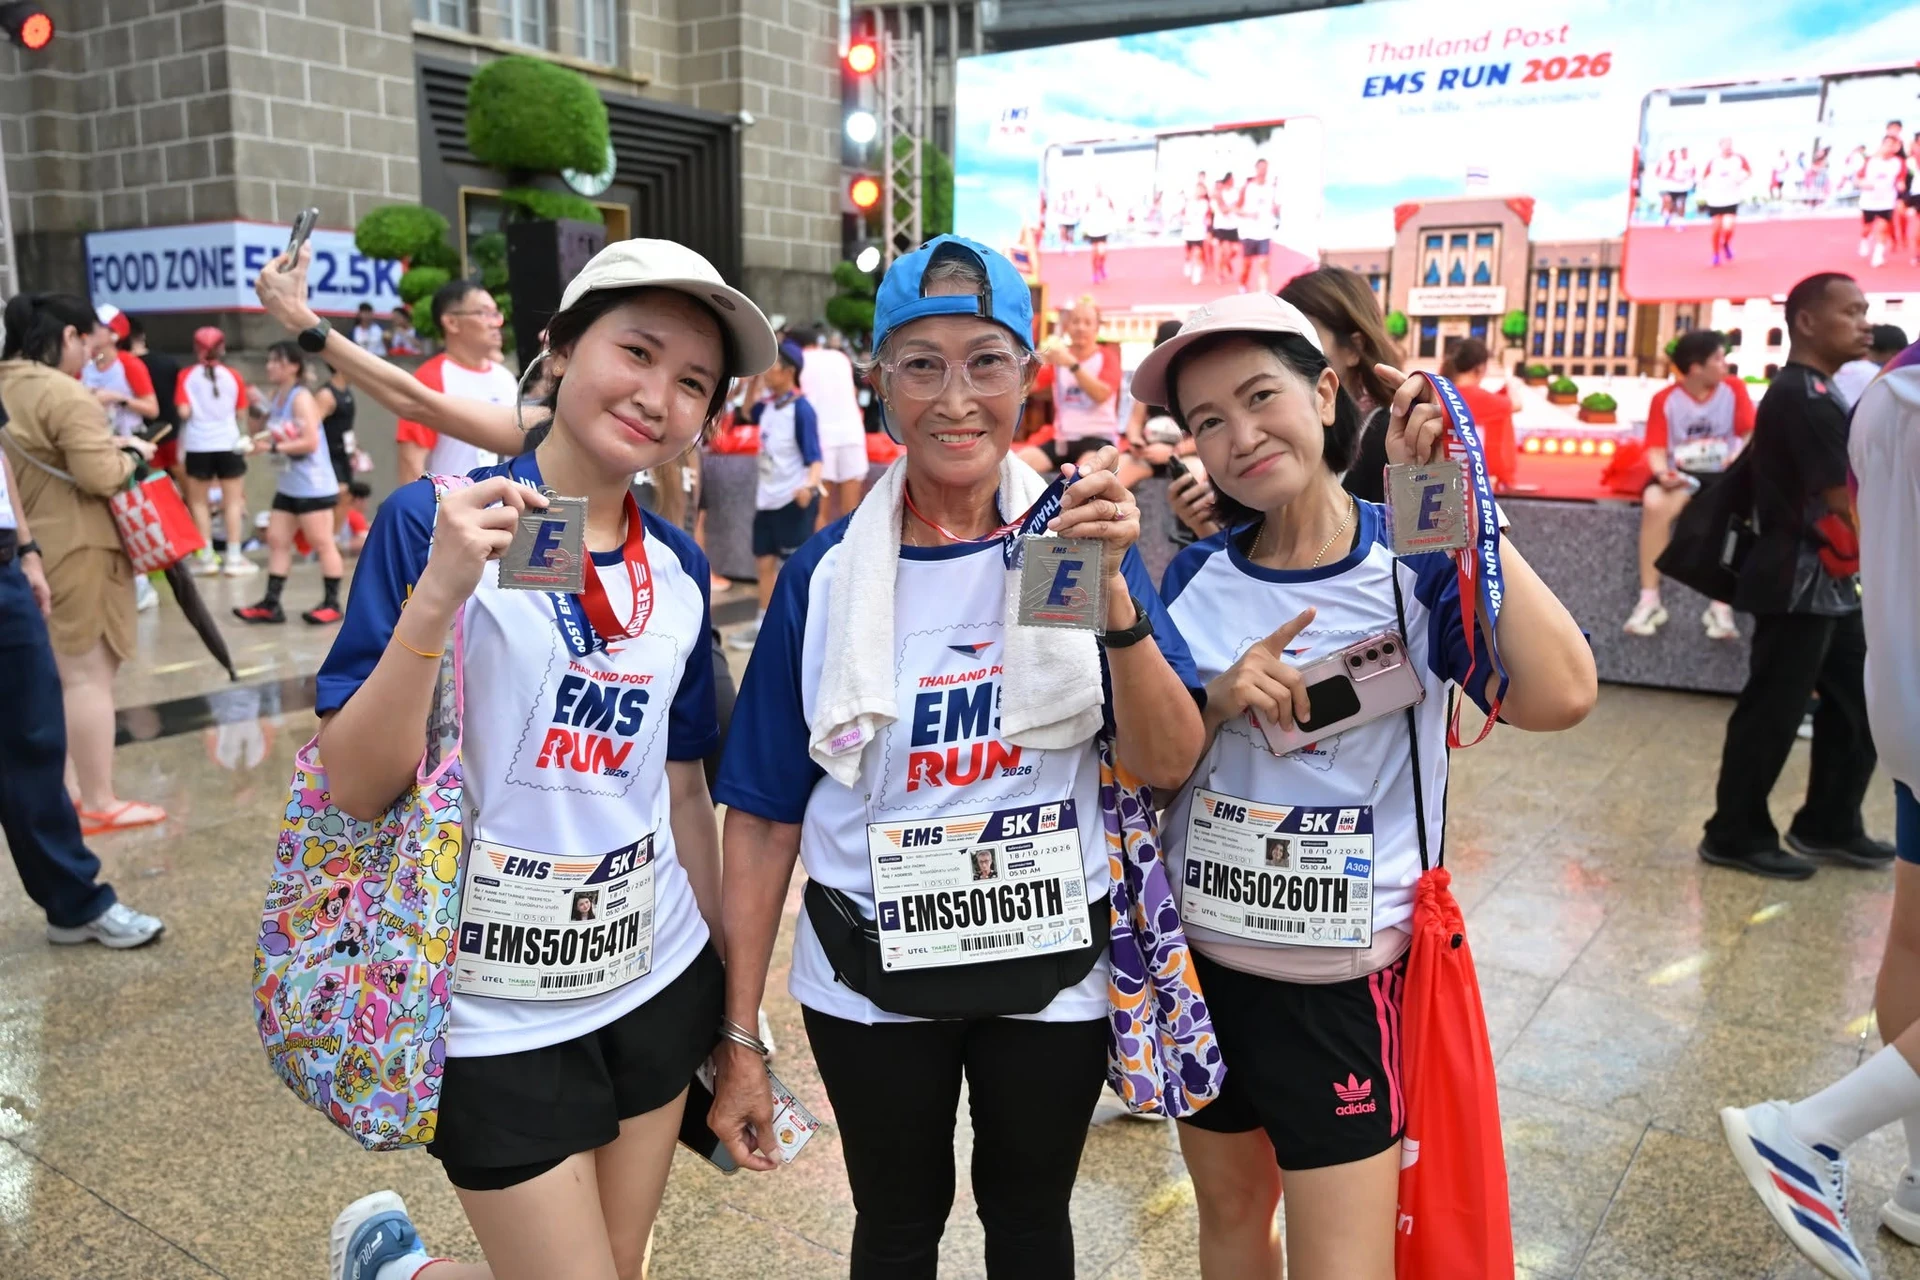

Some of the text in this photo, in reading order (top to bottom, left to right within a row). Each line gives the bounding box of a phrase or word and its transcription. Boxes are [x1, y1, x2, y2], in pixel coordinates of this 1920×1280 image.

[1368, 24, 1570, 63] Thailand Post
[1362, 52, 1613, 97] EMS RUN 2026
[92, 252, 159, 293] FOOD
[165, 247, 236, 291] ZONE
[1434, 375, 1477, 448] THAILAND
[1471, 450, 1489, 496] POST
[1481, 499, 1495, 535] EMS
[1052, 546, 1067, 554] EMS
[1482, 539, 1498, 576] RUN
[1487, 579, 1502, 617] 202
[569, 660, 654, 685] THAILAND POST
[918, 669, 987, 688] THAILAND
[552, 674, 650, 737] EMS
[535, 728, 634, 774] RUN
[603, 767, 629, 778] 2026
[906, 740, 1022, 793] RUN
[1001, 765, 1032, 778] 2026
[1041, 813, 1056, 823] EMS
[1213, 801, 1246, 824] EMS
[1299, 813, 1332, 832] 5K
[1340, 817, 1355, 825] EMS
[1001, 812, 1033, 837] 5K
[1040, 821, 1056, 829] RUN
[902, 826, 943, 848] EMS
[503, 855, 552, 880] EMS
[608, 850, 633, 877] 5K
[1189, 866, 1198, 880] F
[1345, 861, 1369, 874] A309
[1202, 860, 1348, 913] EMS50260TH
[884, 908, 895, 924] F
[902, 878, 1064, 933] EMS50163TH
[1201, 908, 1217, 918] UTEL
[466, 930, 479, 945] F
[484, 910, 640, 966] EMS50154TH
[908, 947, 928, 955] UTEL
[481, 975, 504, 984] UTEL
[314, 1034, 342, 1055] BEGIN
[1335, 1100, 1377, 1116] adidas
